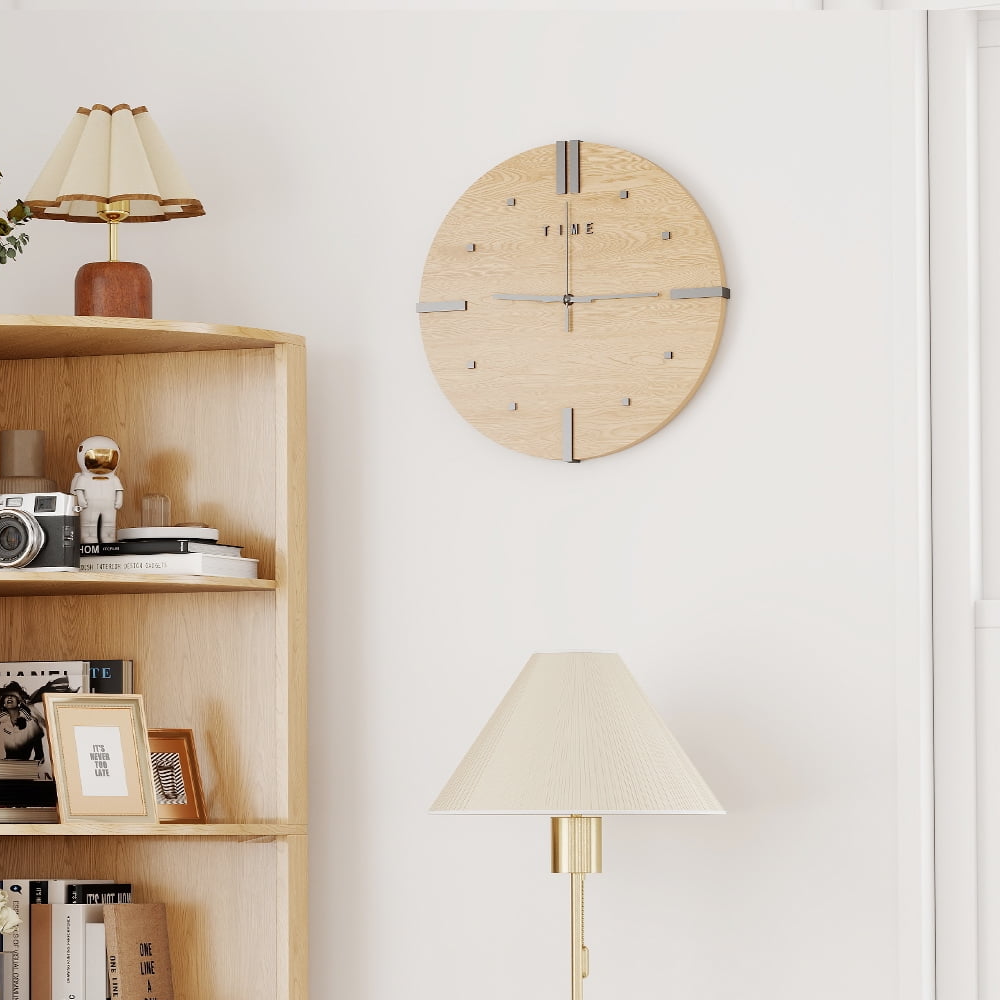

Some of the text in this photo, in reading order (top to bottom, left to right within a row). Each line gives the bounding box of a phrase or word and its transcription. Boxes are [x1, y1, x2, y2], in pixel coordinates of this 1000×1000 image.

[544, 223, 594, 237] TIME
[92, 744, 106, 753] IT'S
[90, 752, 111, 761] NEVER
[94, 760, 108, 769] TOO
[94, 768, 110, 777] LATE
[140, 943, 153, 957] ONE
[109, 955, 117, 973] ONE
[141, 961, 155, 975] LINE
[147, 979, 152, 993] A
